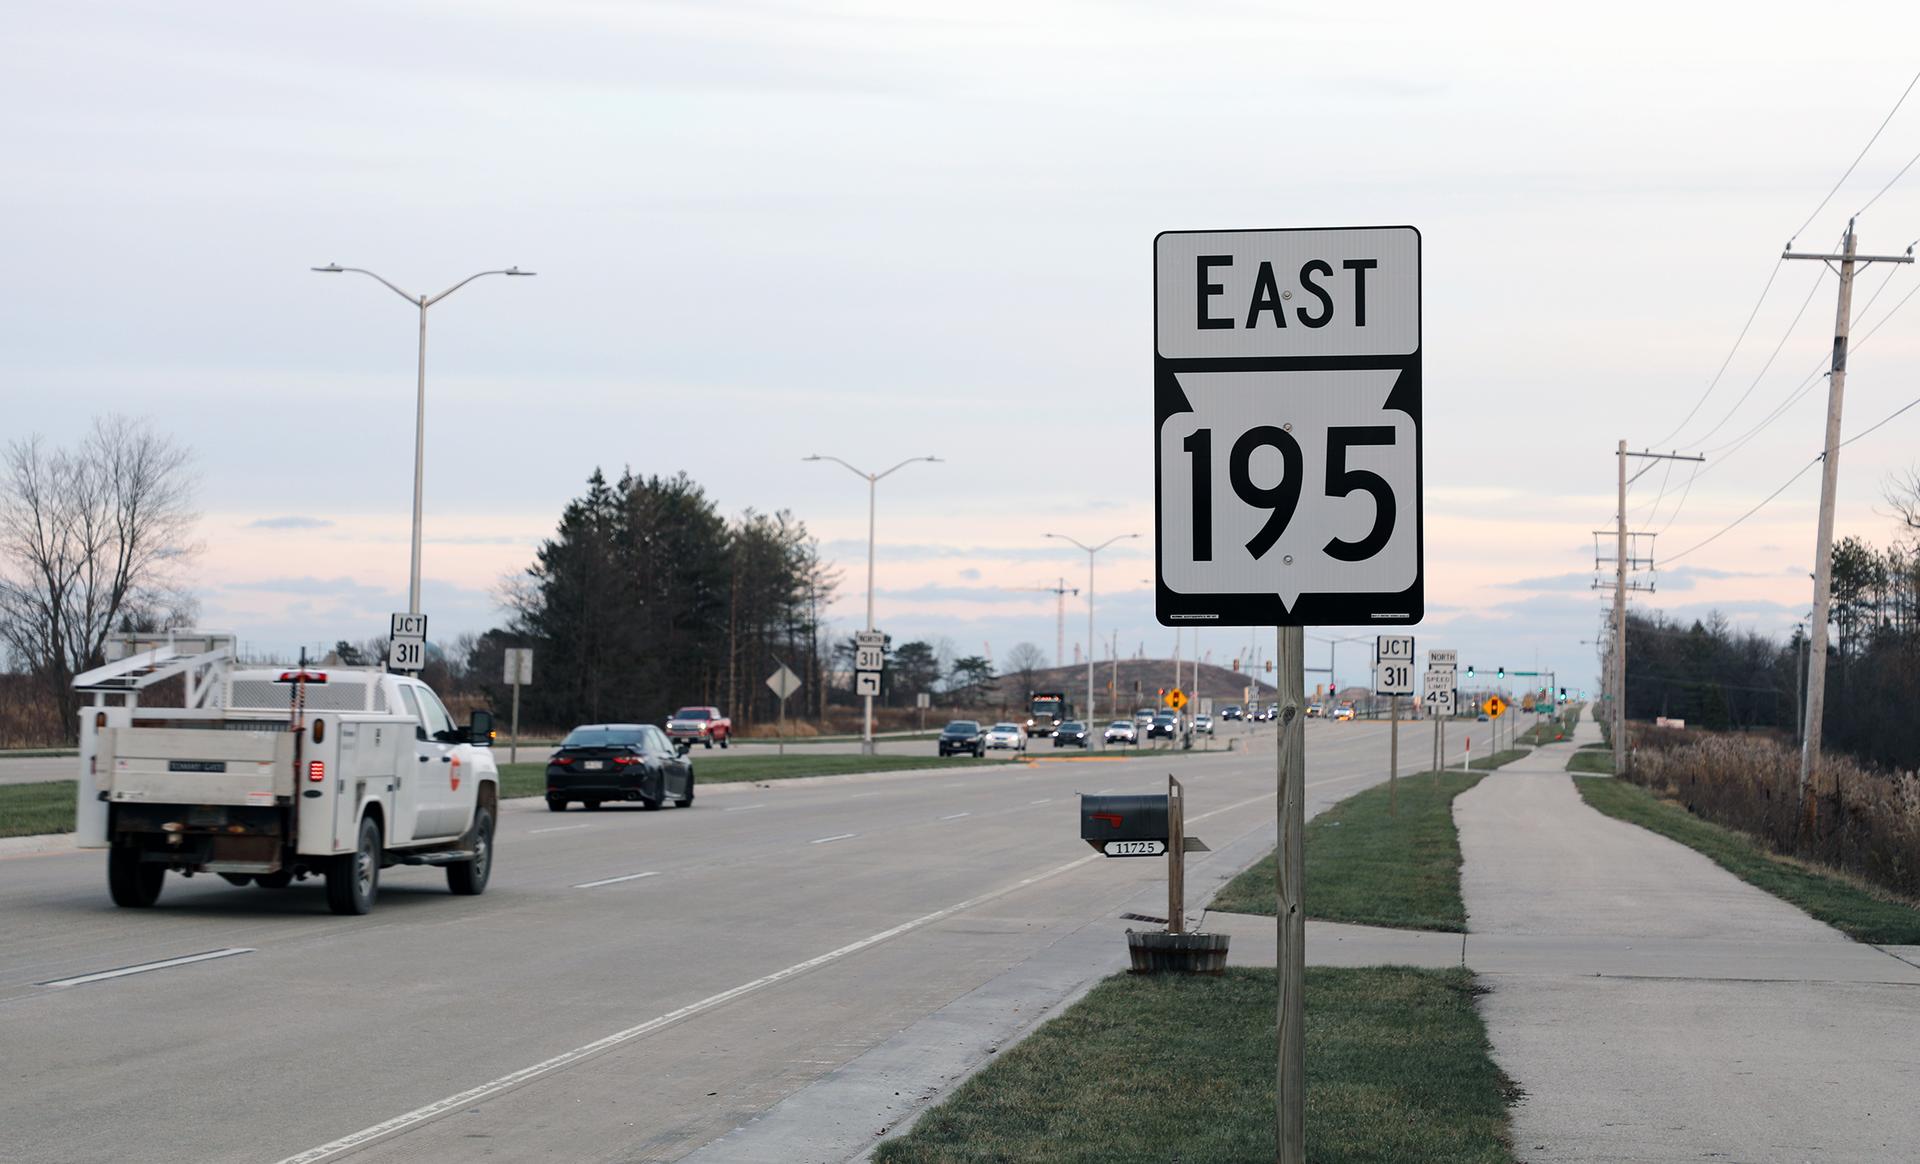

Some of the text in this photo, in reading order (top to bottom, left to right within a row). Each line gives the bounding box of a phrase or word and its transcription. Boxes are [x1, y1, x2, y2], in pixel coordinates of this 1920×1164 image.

[1197, 254, 1378, 330] EAST
[1183, 425, 1397, 562] 195
[396, 617, 422, 633] JCT
[396, 643, 419, 663] 311
[1382, 640, 1409, 655] JCT
[860, 651, 880, 666] 311
[1431, 653, 1455, 661] NORTH
[1384, 667, 1407, 687] 311
[1426, 691, 1449, 703] 45
[1116, 842, 1155, 854] 11725
